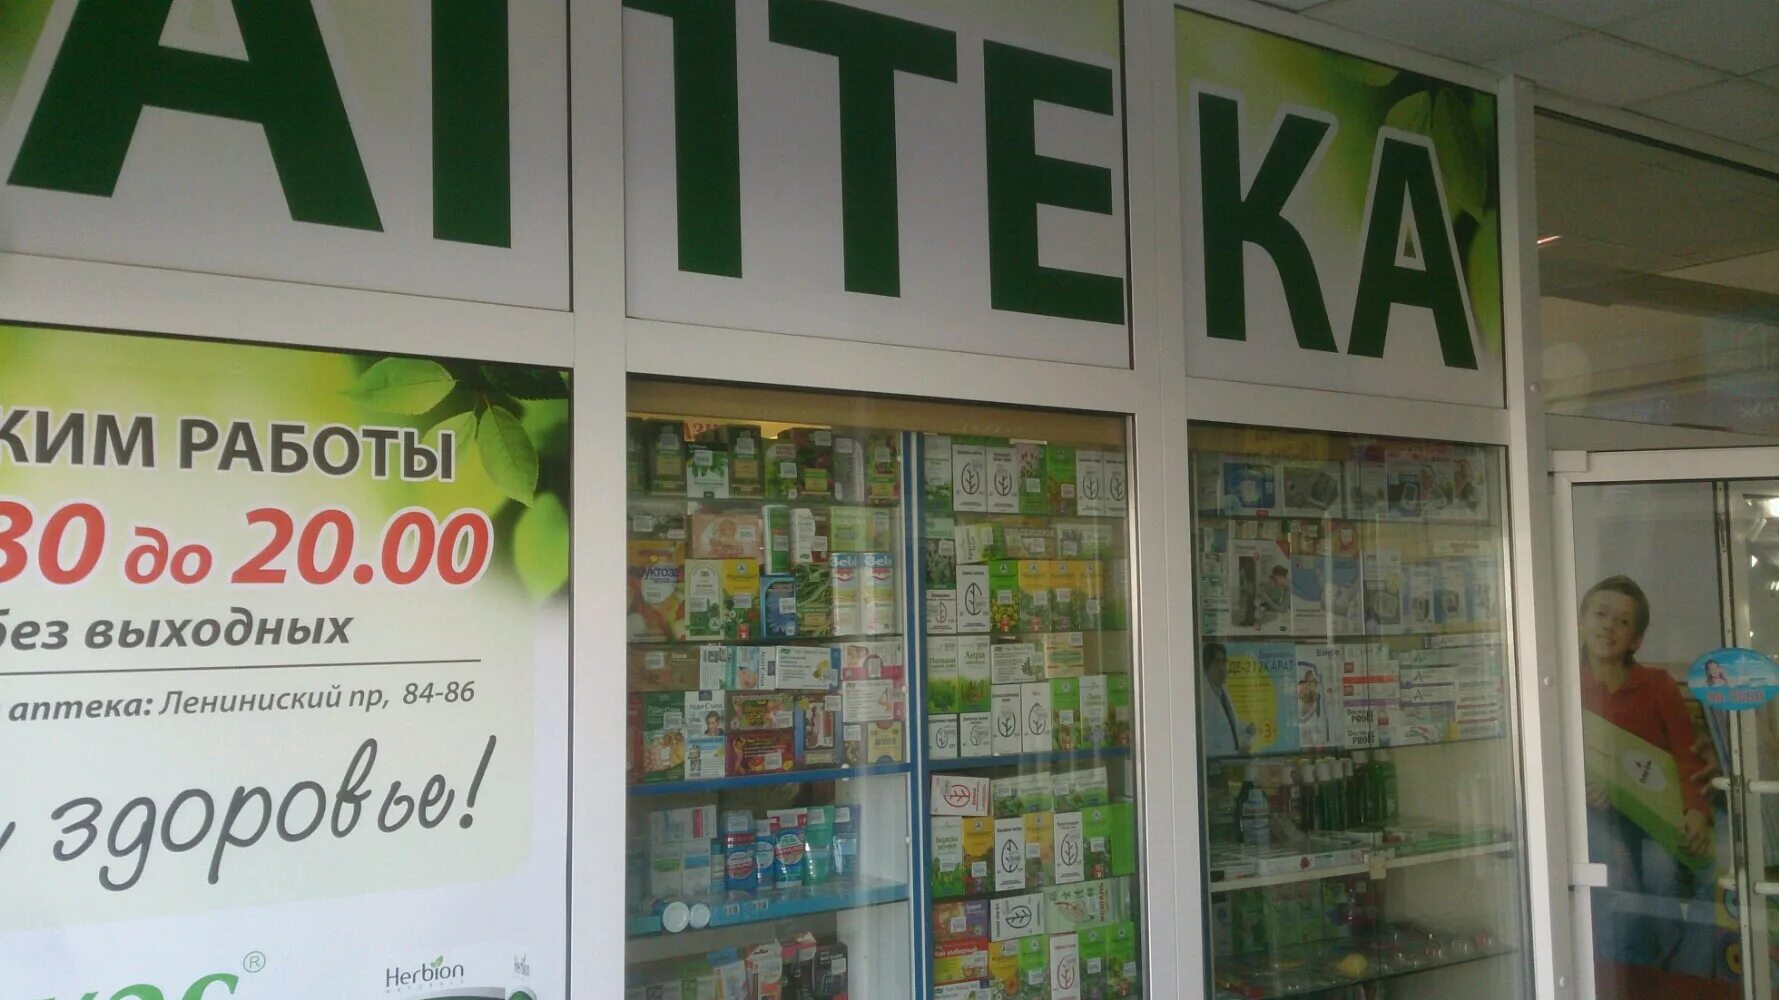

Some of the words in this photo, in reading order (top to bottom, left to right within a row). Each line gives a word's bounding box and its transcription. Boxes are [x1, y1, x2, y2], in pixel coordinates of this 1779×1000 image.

[7, 0, 1479, 370] АПТЕКА
[180, 418, 453, 480] РАБОТЫ
[124, 525, 213, 585] до
[230, 507, 489, 585] 20.00
[84, 606, 353, 650] выходных
[8, 694, 152, 723] аптека:
[158, 685, 342, 716] Лениниский
[349, 687, 390, 713] пр,
[402, 680, 475, 705] 84-86
[51, 734, 498, 892] здоровье!
[386, 963, 464, 988] Herbion
